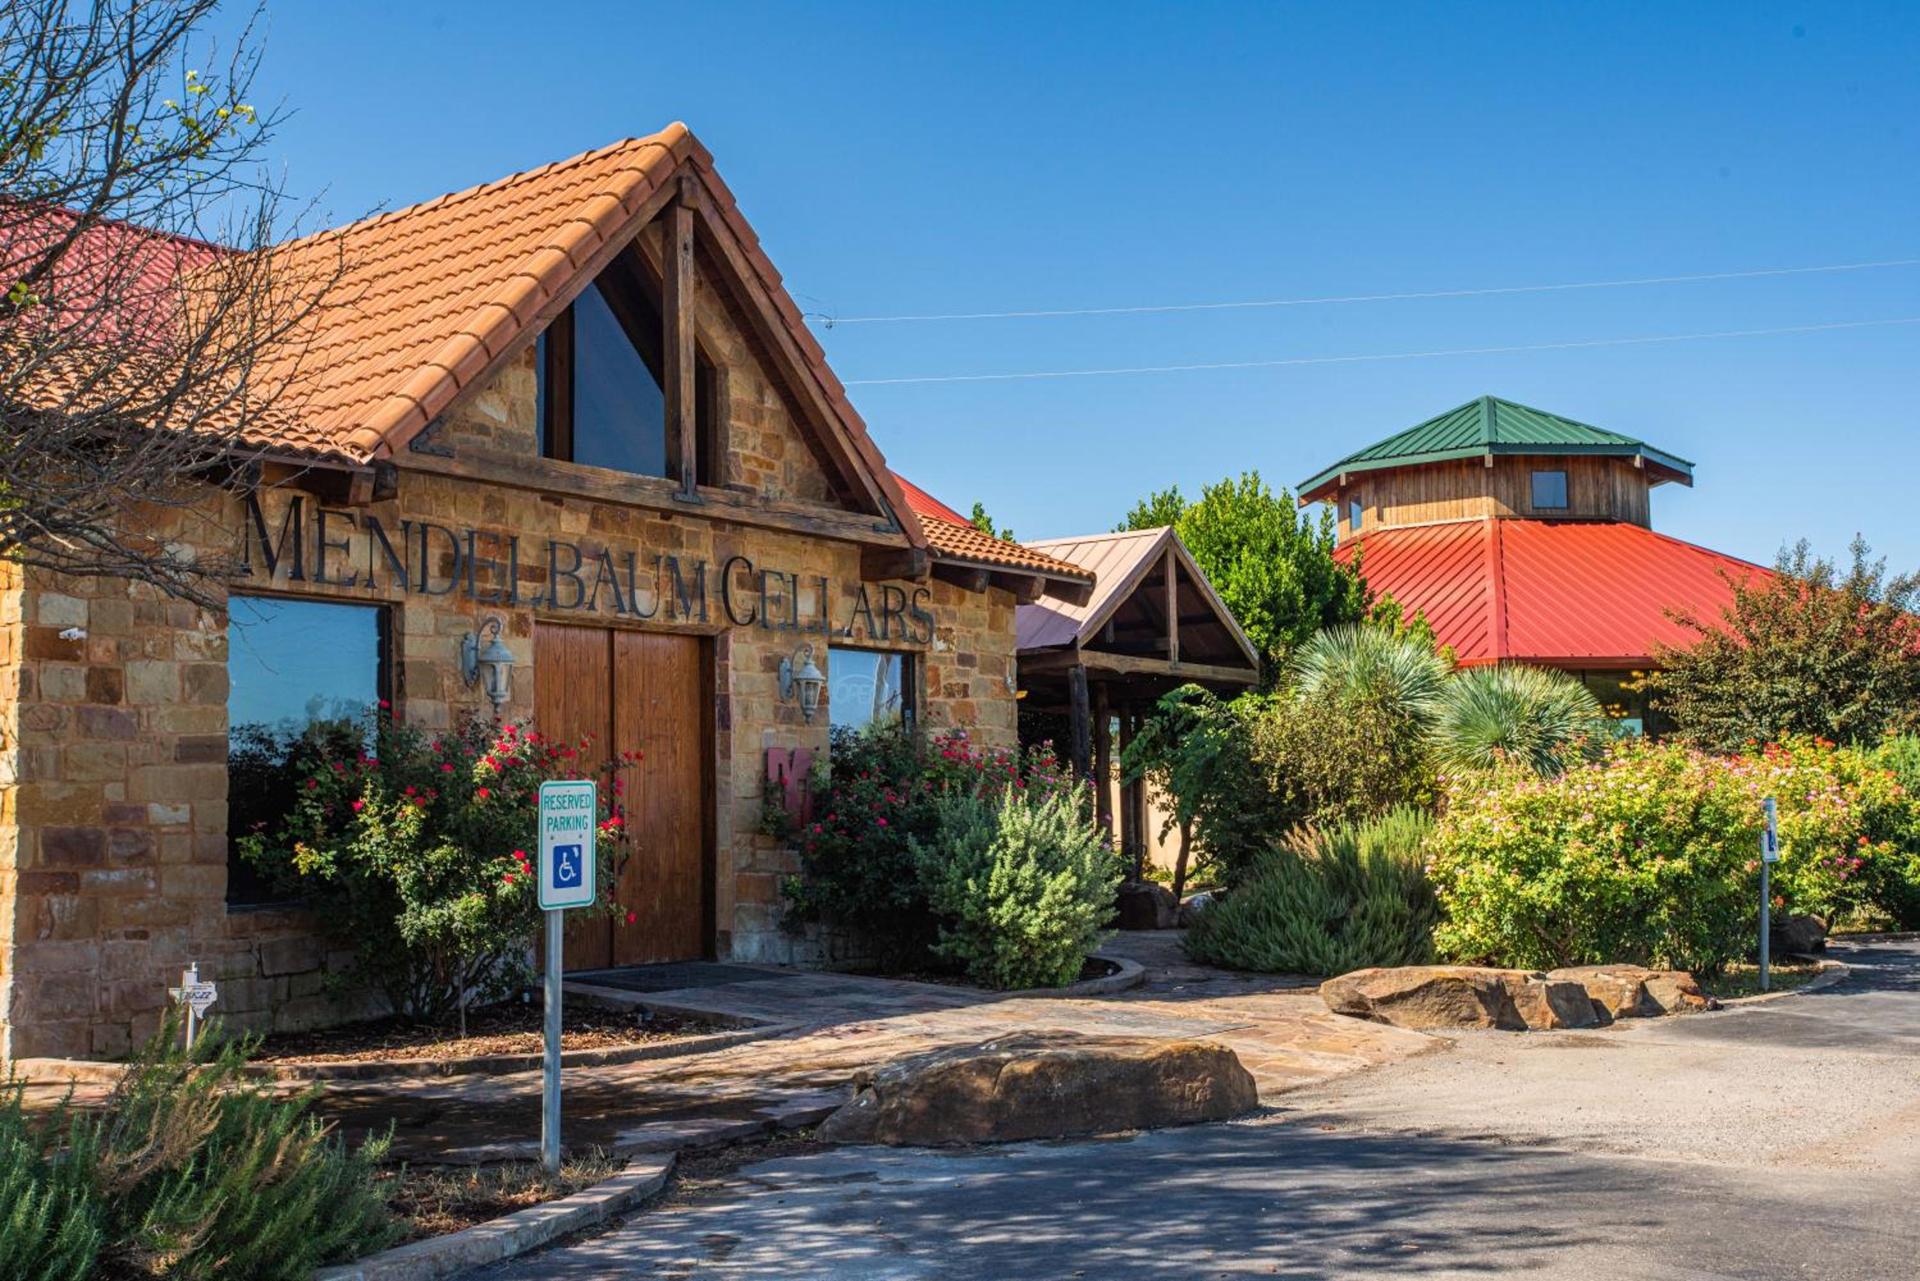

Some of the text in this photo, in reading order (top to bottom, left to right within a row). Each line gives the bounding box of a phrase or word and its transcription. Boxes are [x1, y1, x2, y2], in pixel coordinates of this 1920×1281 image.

[240, 489, 934, 645] MENDELBAUM CELLARS
[543, 793, 591, 811] RESERVED
[546, 815, 588, 832] PARKING
